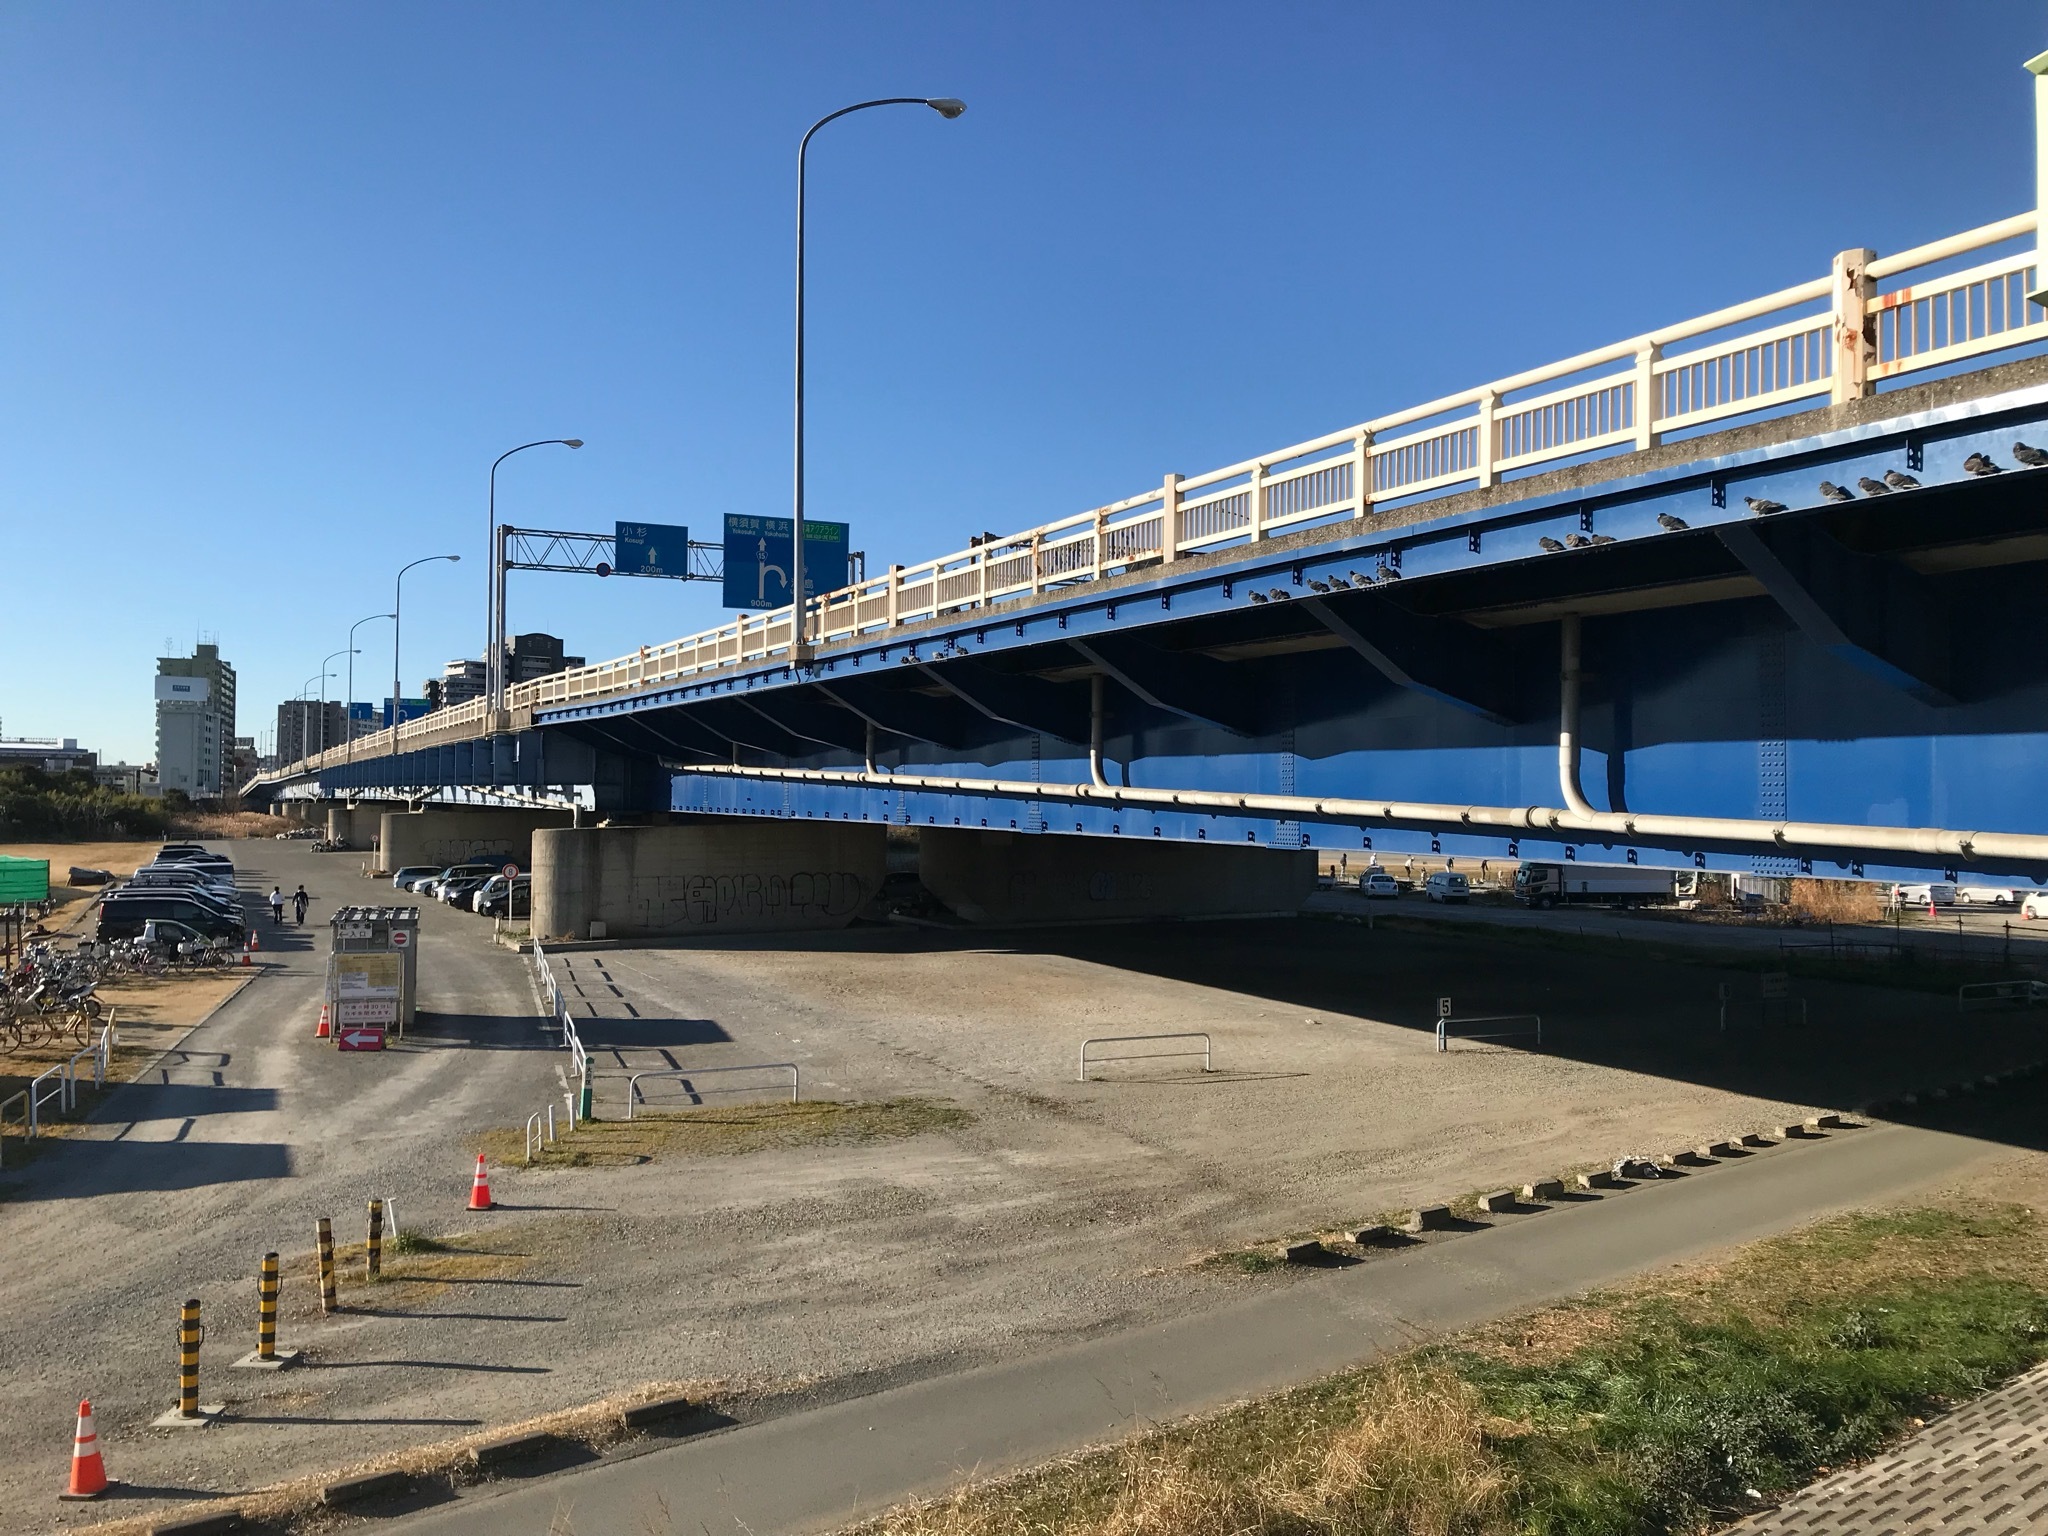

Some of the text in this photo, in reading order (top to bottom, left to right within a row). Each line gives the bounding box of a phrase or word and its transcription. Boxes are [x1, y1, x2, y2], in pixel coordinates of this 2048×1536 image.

[728, 516, 789, 532] 横須賀 横浜
[622, 526, 648, 537] 小杉
[732, 528, 756, 536] Yokosuka
[624, 537, 645, 545] Kosugi
[640, 565, 663, 573] 200m
[750, 599, 773, 608] 900m
[1442, 999, 1450, 1014] 5
